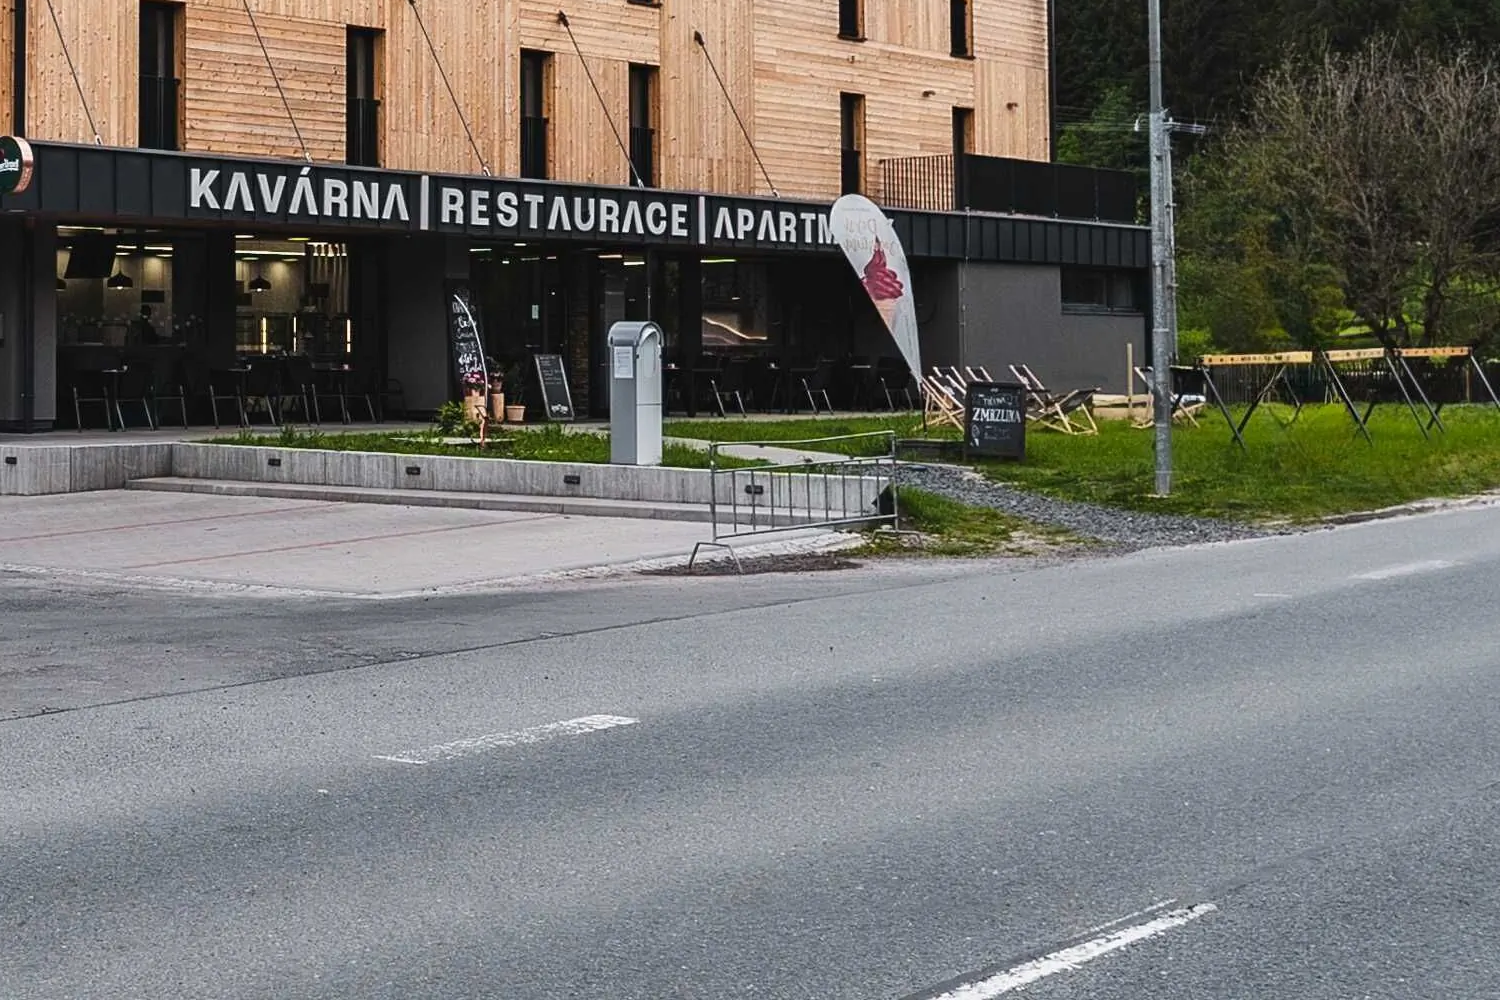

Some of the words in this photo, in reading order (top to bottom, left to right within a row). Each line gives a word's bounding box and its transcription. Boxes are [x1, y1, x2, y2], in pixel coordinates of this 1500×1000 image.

[190, 166, 410, 222] KAVÁRNA
[441, 187, 688, 237] RESTAURACE
[713, 206, 843, 245] APARTM
